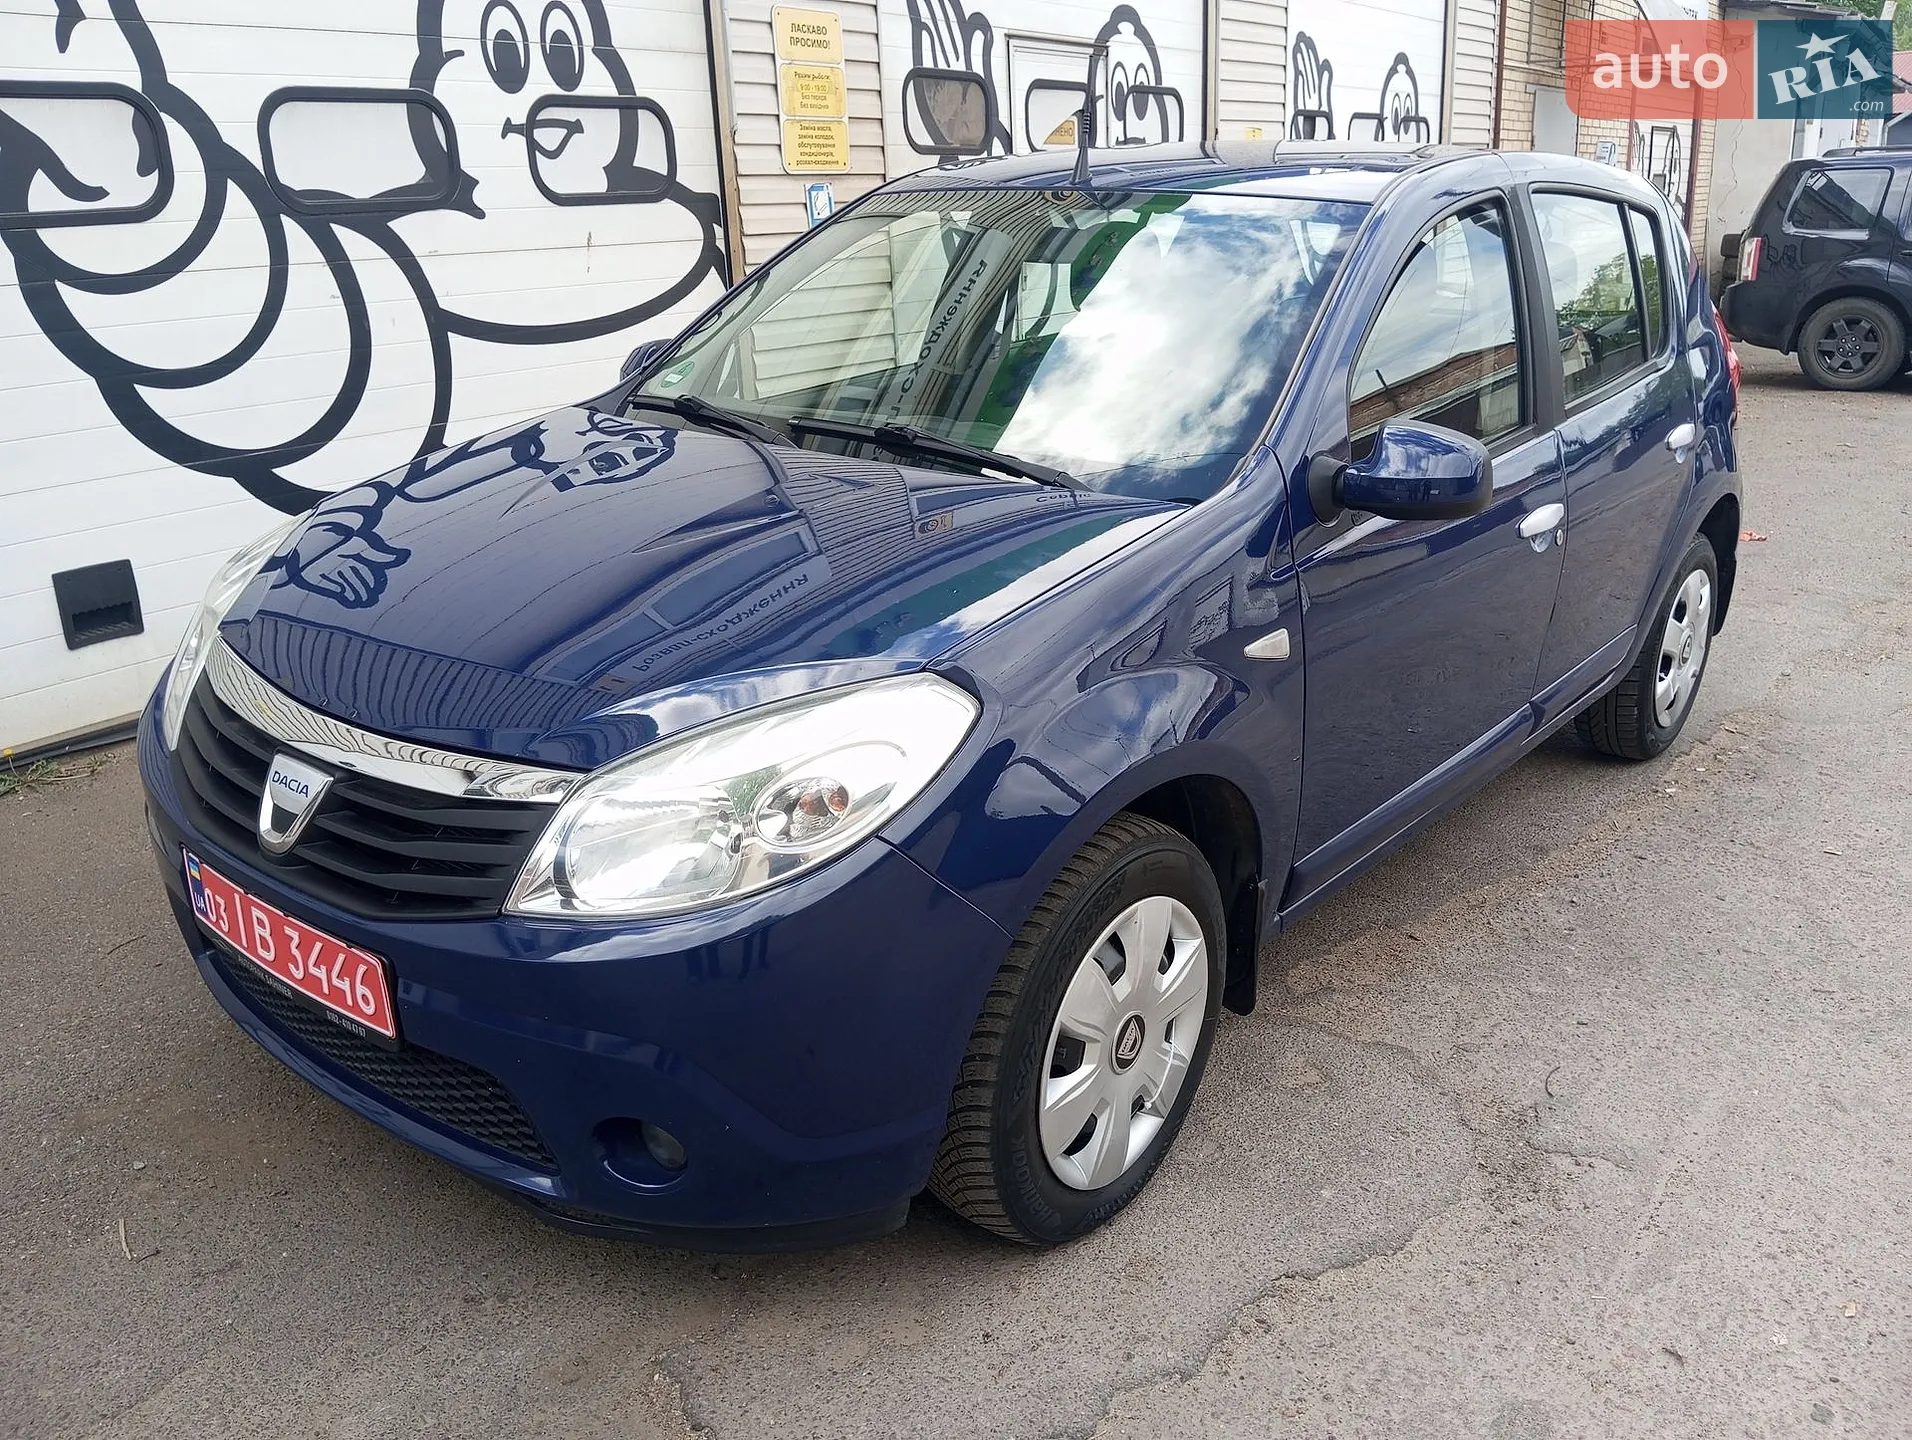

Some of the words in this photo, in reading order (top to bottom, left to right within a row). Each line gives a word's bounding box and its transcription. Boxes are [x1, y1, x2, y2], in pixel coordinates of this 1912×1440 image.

[790, 22, 828, 36] ЛАСКАВО
[789, 36, 831, 50] ПРОСИМО!
[271, 770, 310, 798] DACIA
[195, 894, 207, 913] UA
[204, 887, 229, 933] 03
[233, 892, 277, 962] IB
[283, 925, 377, 1016] 3446
